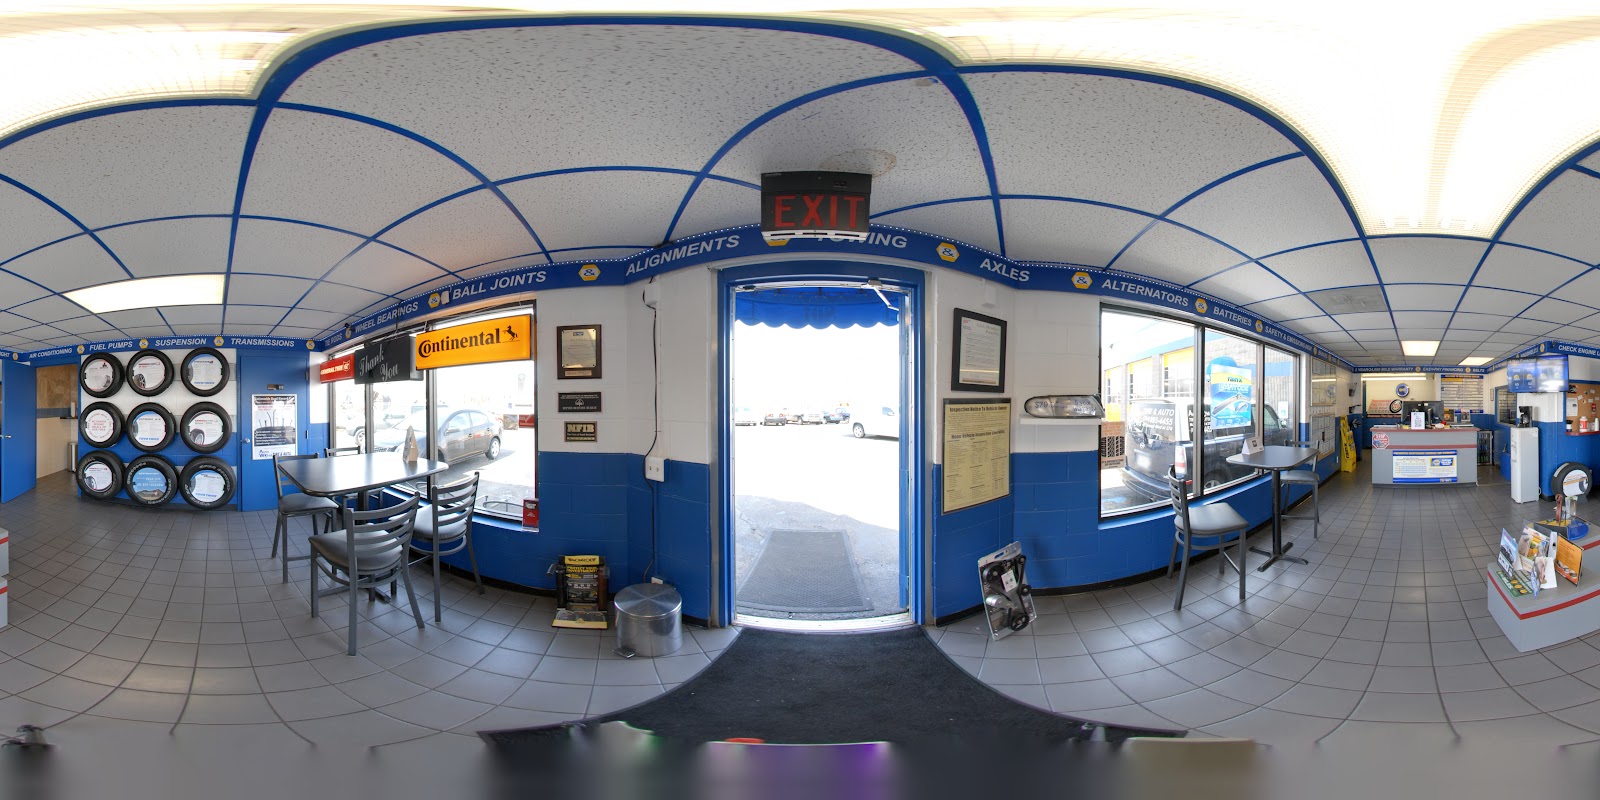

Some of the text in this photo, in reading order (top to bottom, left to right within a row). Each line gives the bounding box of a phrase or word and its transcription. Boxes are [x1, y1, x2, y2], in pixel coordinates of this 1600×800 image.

[774, 195, 865, 228] EXIT
[625, 234, 740, 277] ALIGNMENTS
[980, 258, 1030, 282] AXLES
[452, 270, 547, 300] BALL JOINTS
[1101, 278, 1189, 307] ALTERNATORS
[355, 301, 419, 333] WHEEL BEARINGS
[1213, 306, 1252, 327] BATTERIES
[155, 337, 207, 347] SUSPENSION
[230, 338, 295, 347] TRANSMISSIONS
[418, 328, 501, 358] Continental
[1264, 325, 1283, 340] SAFETY
[89, 341, 133, 351] FUEL PUMPS
[1558, 345, 1578, 353] CHECK
[1577, 347, 1597, 356] ENGINE
[360, 343, 385, 376] Thank
[379, 363, 398, 381] You
[1158, 408, 1175, 416] AUTO
[566, 423, 595, 433] NFIB
